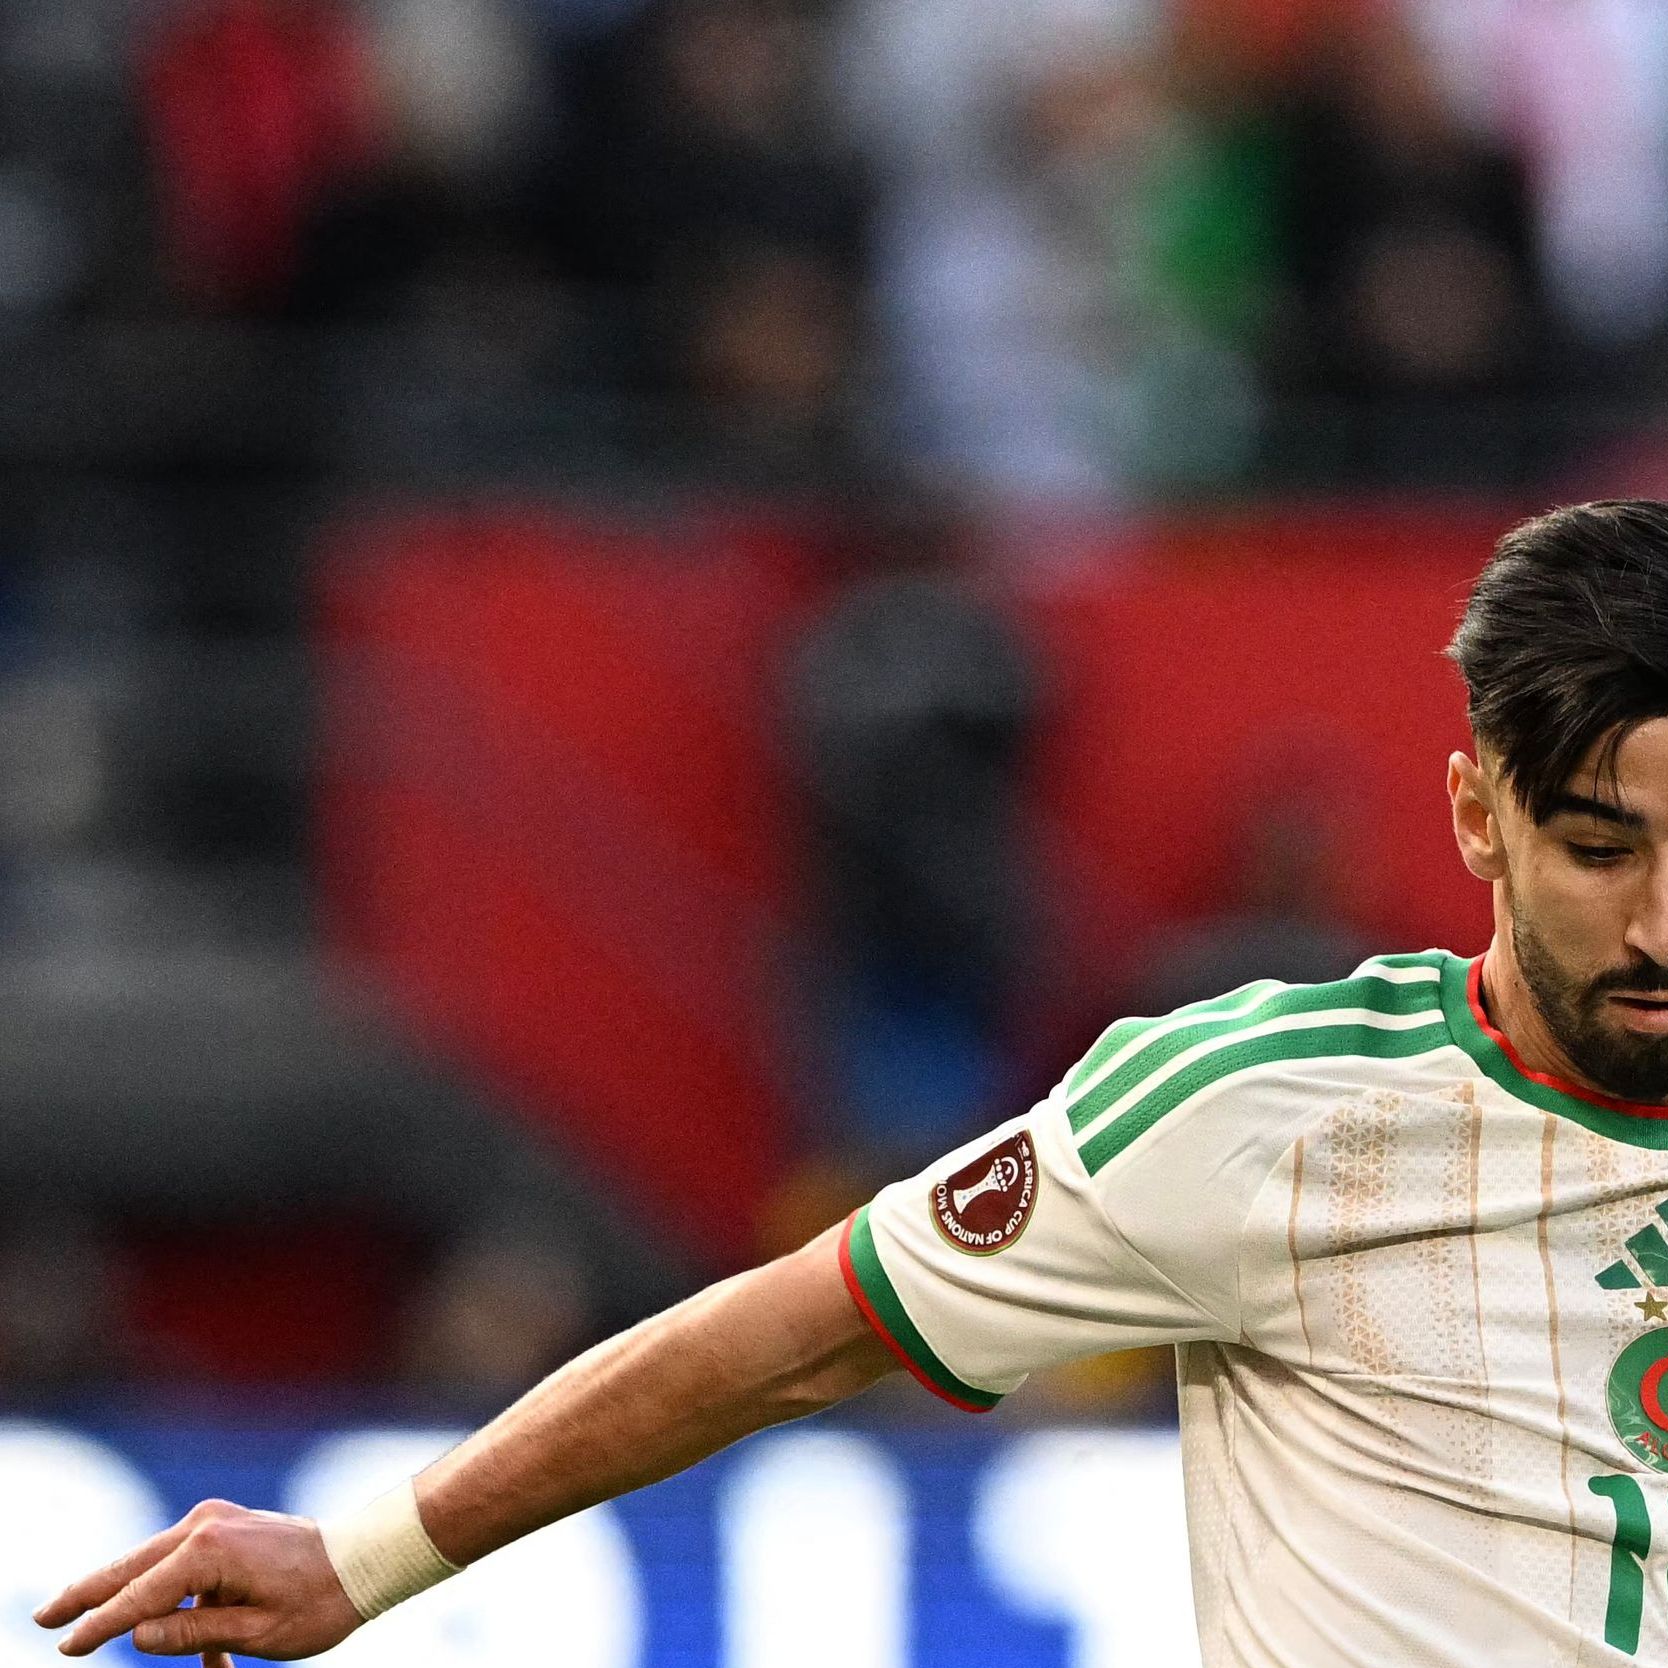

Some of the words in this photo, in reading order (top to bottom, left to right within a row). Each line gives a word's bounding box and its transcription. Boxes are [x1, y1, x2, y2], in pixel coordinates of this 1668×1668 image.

[936, 1180, 948, 1210] MO
[1019, 1160, 1033, 1208] AFRICA
[941, 1211, 985, 1245] NATIONS
[985, 1230, 1003, 1245] OF
[1005, 1211, 1022, 1236] CUP
